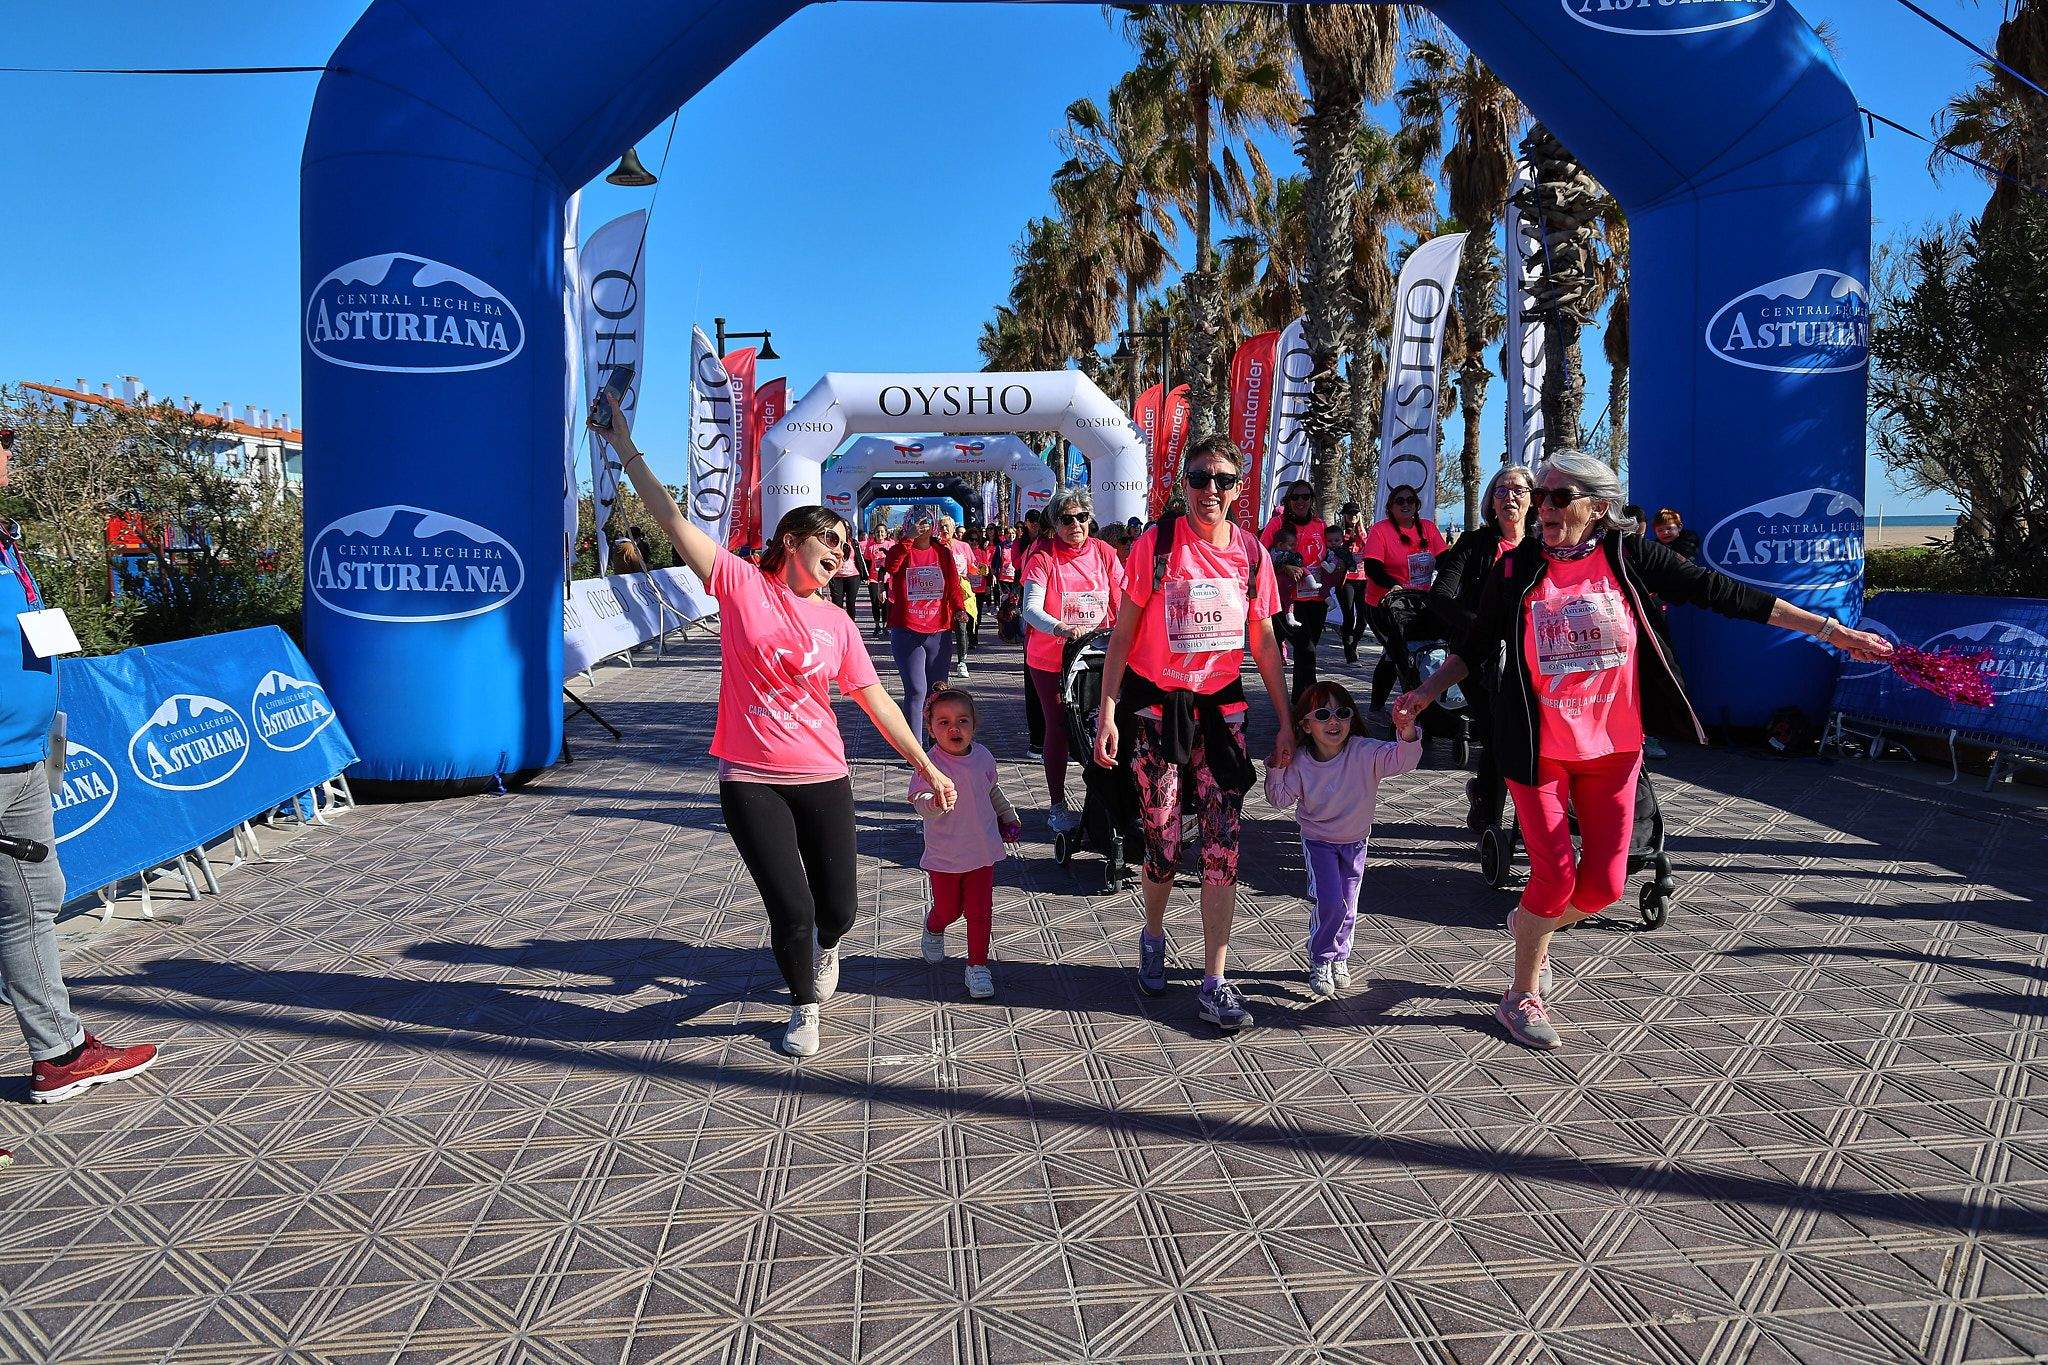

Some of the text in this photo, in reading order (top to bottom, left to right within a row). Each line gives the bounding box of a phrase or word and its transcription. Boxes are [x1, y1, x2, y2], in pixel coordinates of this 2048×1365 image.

[337, 293, 502, 316] CENTRAL LECHERA
[1761, 306, 1831, 318] CENTRAL
[313, 298, 510, 352] ASTURIANA
[878, 384, 1033, 417] OYSHO
[1243, 358, 1264, 451] Santander
[786, 422, 833, 433] OYSHO
[1075, 417, 1121, 428] OYSHO
[693, 352, 732, 521] OYSHO
[1164, 402, 1185, 471] Santander
[767, 485, 810, 495] OYSHO
[881, 482, 945, 490] VOLVO
[1101, 480, 1143, 491] OYSHO
[1757, 523, 1826, 535] CENTRAL
[338, 544, 502, 559] CENTRAL LECHERA
[315, 546, 510, 593] ASTURIANA
[1078, 610, 1096, 619] 016
[1194, 610, 1222, 623] 016
[1563, 605, 1596, 615] ASTURIANA
[1568, 627, 1602, 643] 016
[1177, 641, 1203, 649] OYSHO
[200, 714, 234, 732] LECHERA
[258, 699, 332, 738] ASTURIANA
[147, 726, 246, 780] ASTURIANA
